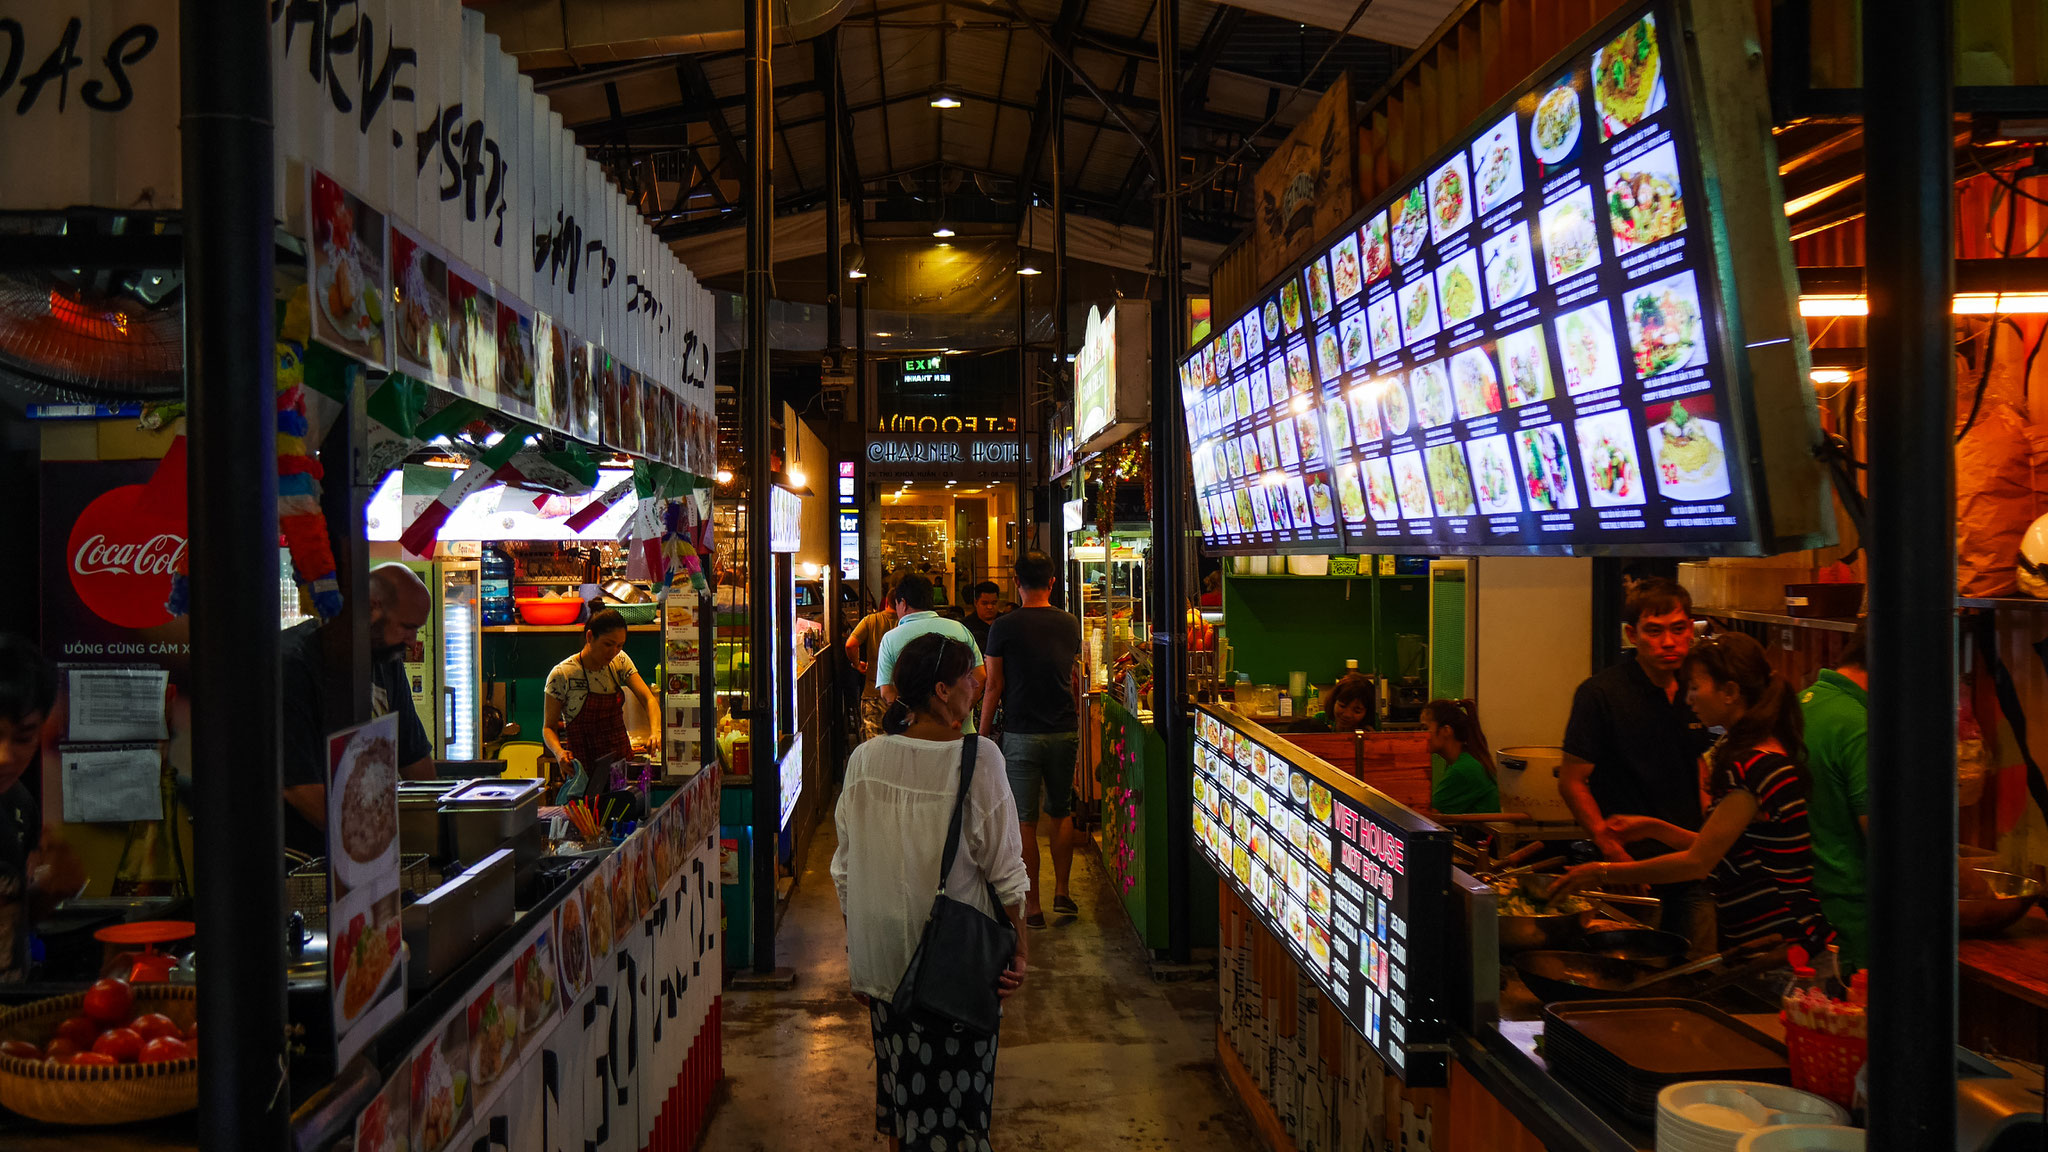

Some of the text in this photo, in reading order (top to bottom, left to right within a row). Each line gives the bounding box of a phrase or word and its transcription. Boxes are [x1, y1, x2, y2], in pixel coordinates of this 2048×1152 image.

[906, 357, 941, 370] EXIT
[867, 442, 1032, 462] CHARNER HOTEL
[75, 534, 188, 575] Coca-Col
[1360, 814, 1404, 876] HOUSE
